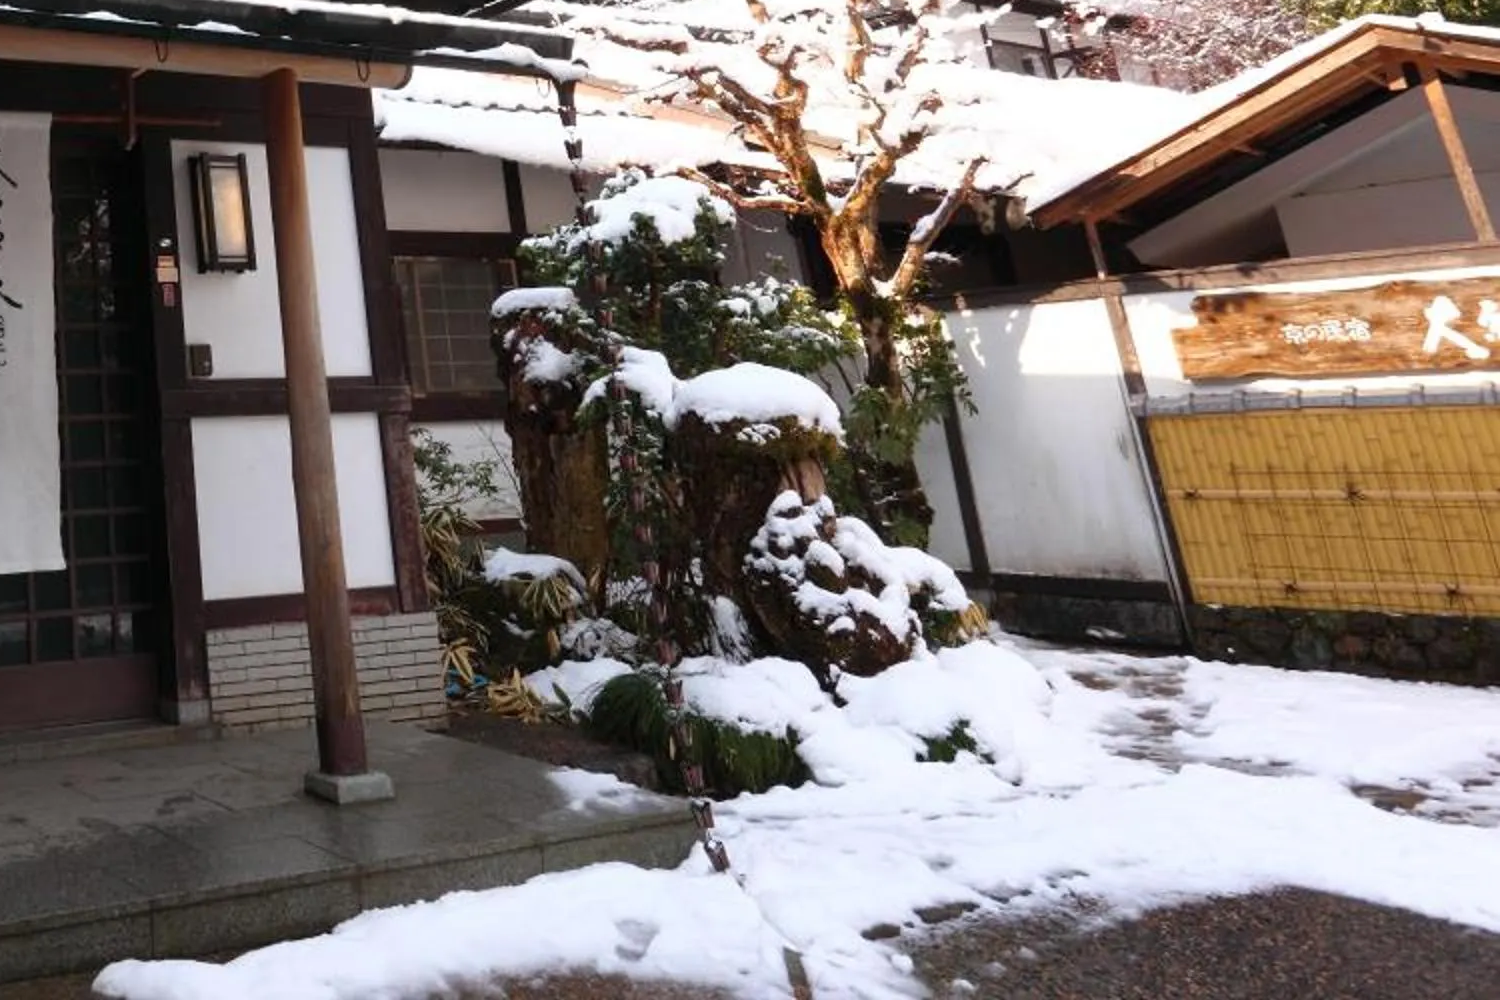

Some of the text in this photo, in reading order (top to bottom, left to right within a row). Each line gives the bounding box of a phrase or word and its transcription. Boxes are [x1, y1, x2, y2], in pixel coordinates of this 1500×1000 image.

[1281, 295, 1500, 360] 京の民宿 大
